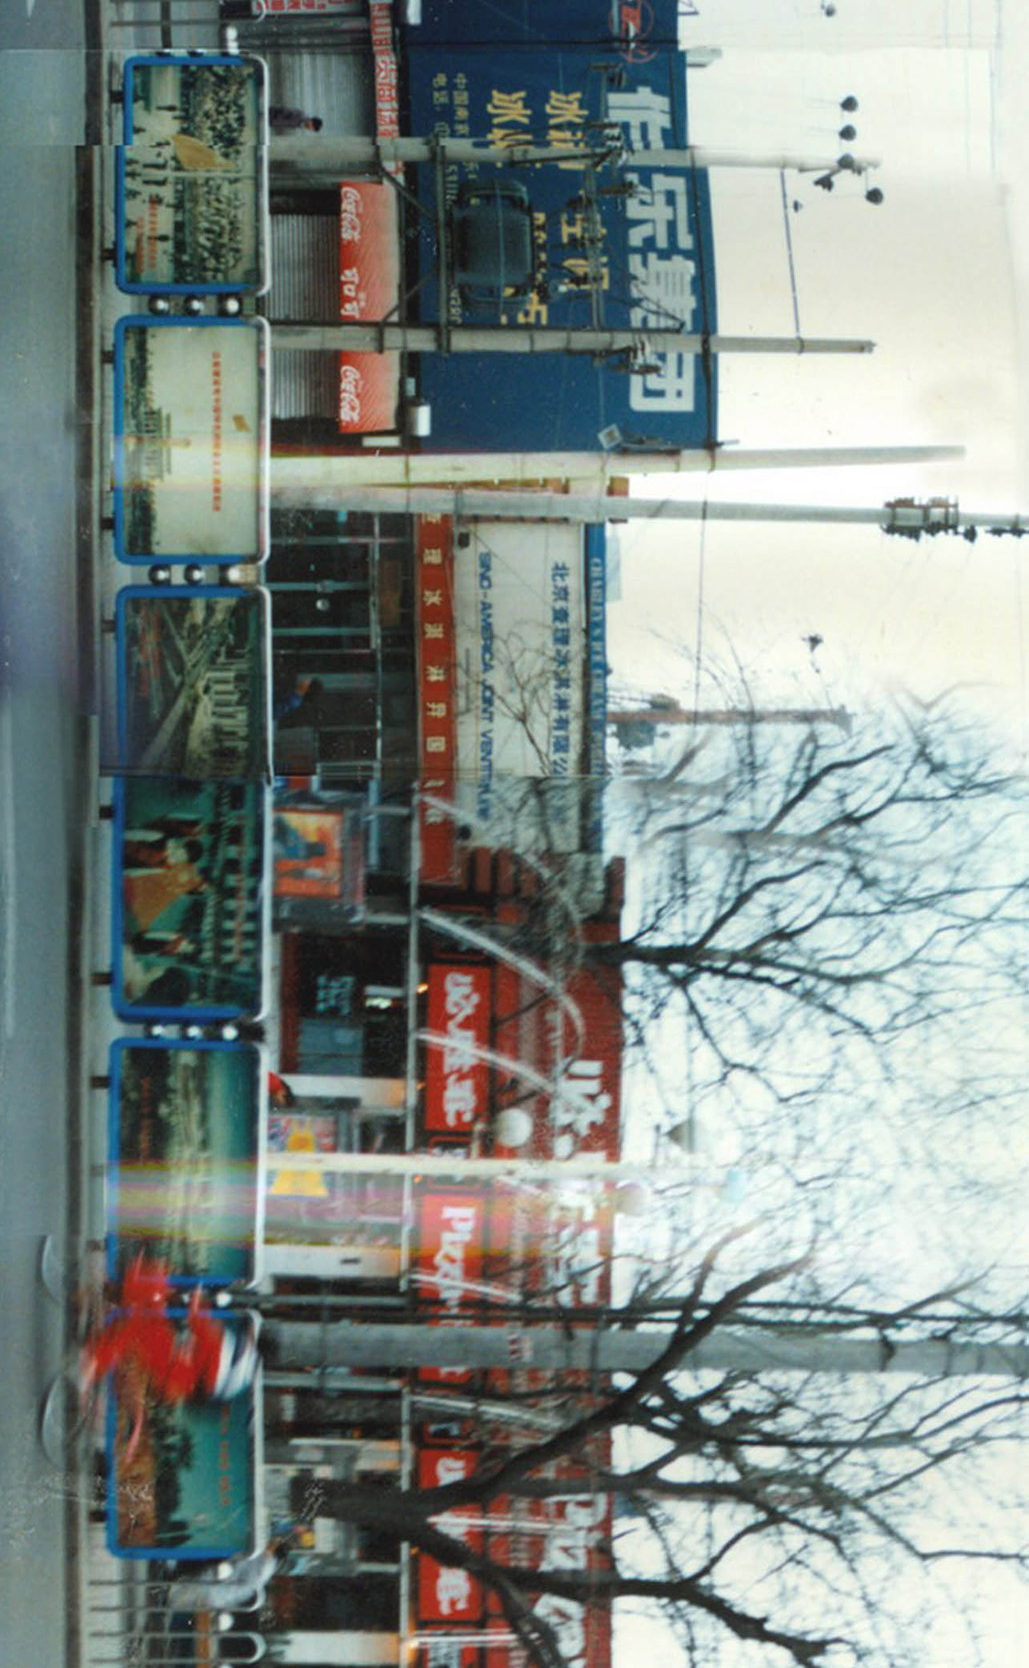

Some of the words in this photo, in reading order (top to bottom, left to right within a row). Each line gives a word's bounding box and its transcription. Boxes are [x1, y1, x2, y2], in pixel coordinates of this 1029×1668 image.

[340, 268, 360, 319] 可口可
[550, 562, 571, 776] 北京查理冰淇淋有限公
